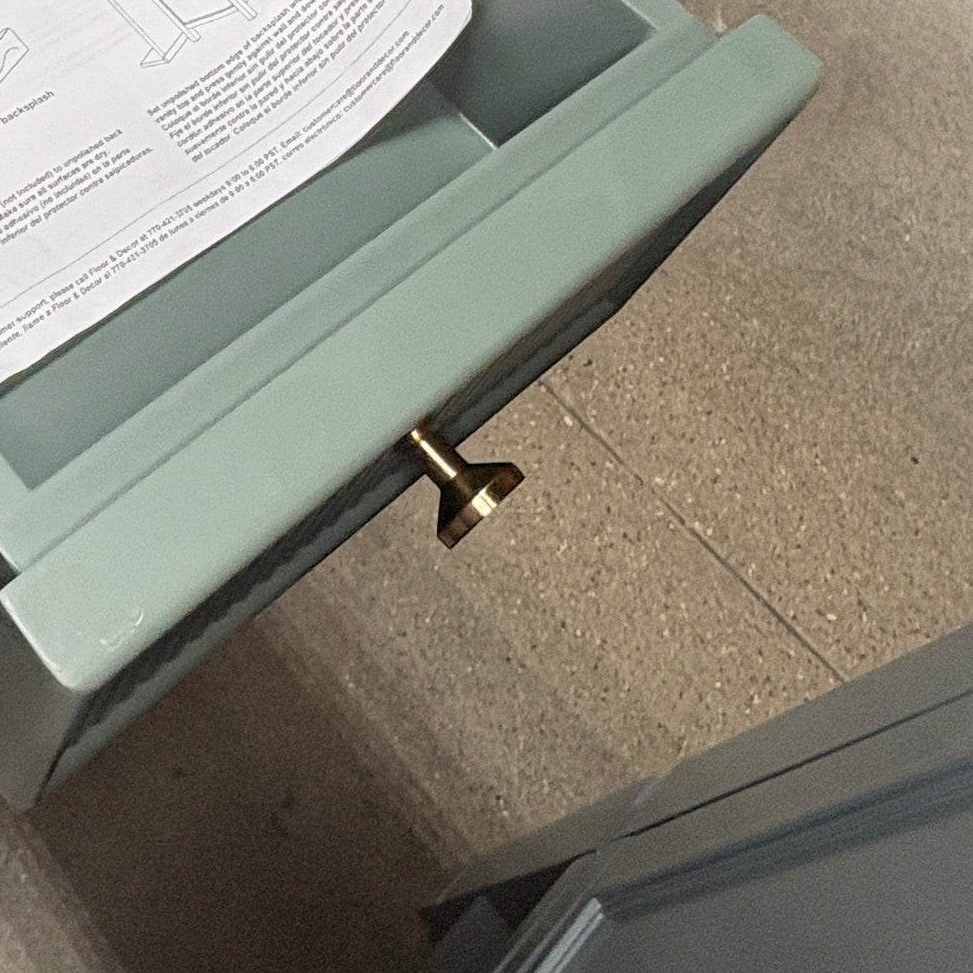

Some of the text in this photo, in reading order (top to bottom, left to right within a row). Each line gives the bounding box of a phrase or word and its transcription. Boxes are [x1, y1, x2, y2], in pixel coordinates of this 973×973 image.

[155, 108, 177, 123] vanity
[177, 100, 190, 110] top
[190, 89, 205, 102] and
[205, 77, 225, 93] press
[225, 60, 247, 79] gently
[247, 37, 273, 61] against
[273, 23, 288, 37] wall
[287, 11, 301, 25] and
[199, 64, 225, 83] bottom
[226, 50, 243, 65] edge
[243, 41, 251, 50] of
[251, 8, 290, 43] backsplash
[0, 90, 55, 125] backsplash
[0, 194, 17, 208] (not
[16, 171, 54, 196] included)
[63, 140, 105, 168] unpolished
[104, 129, 123, 143] back
[4, 206, 39, 230] adhesivo
[40, 197, 54, 209] (no
[92, 166, 102, 175] en
[111, 149, 131, 165] parte
[18, 195, 37, 208] sure
[37, 187, 48, 196] all
[48, 167, 81, 189] surfaces
[82, 159, 94, 169] are
[0, 225, 28, 245] inferior
[30, 215, 43, 227] del
[43, 194, 78, 221] protector
[80, 178, 104, 196] contra
[49, 284, 74, 302] please
[75, 273, 89, 285] call
[88, 260, 109, 276] Floor
[116, 240, 139, 257] Decor
[140, 234, 148, 242] at
